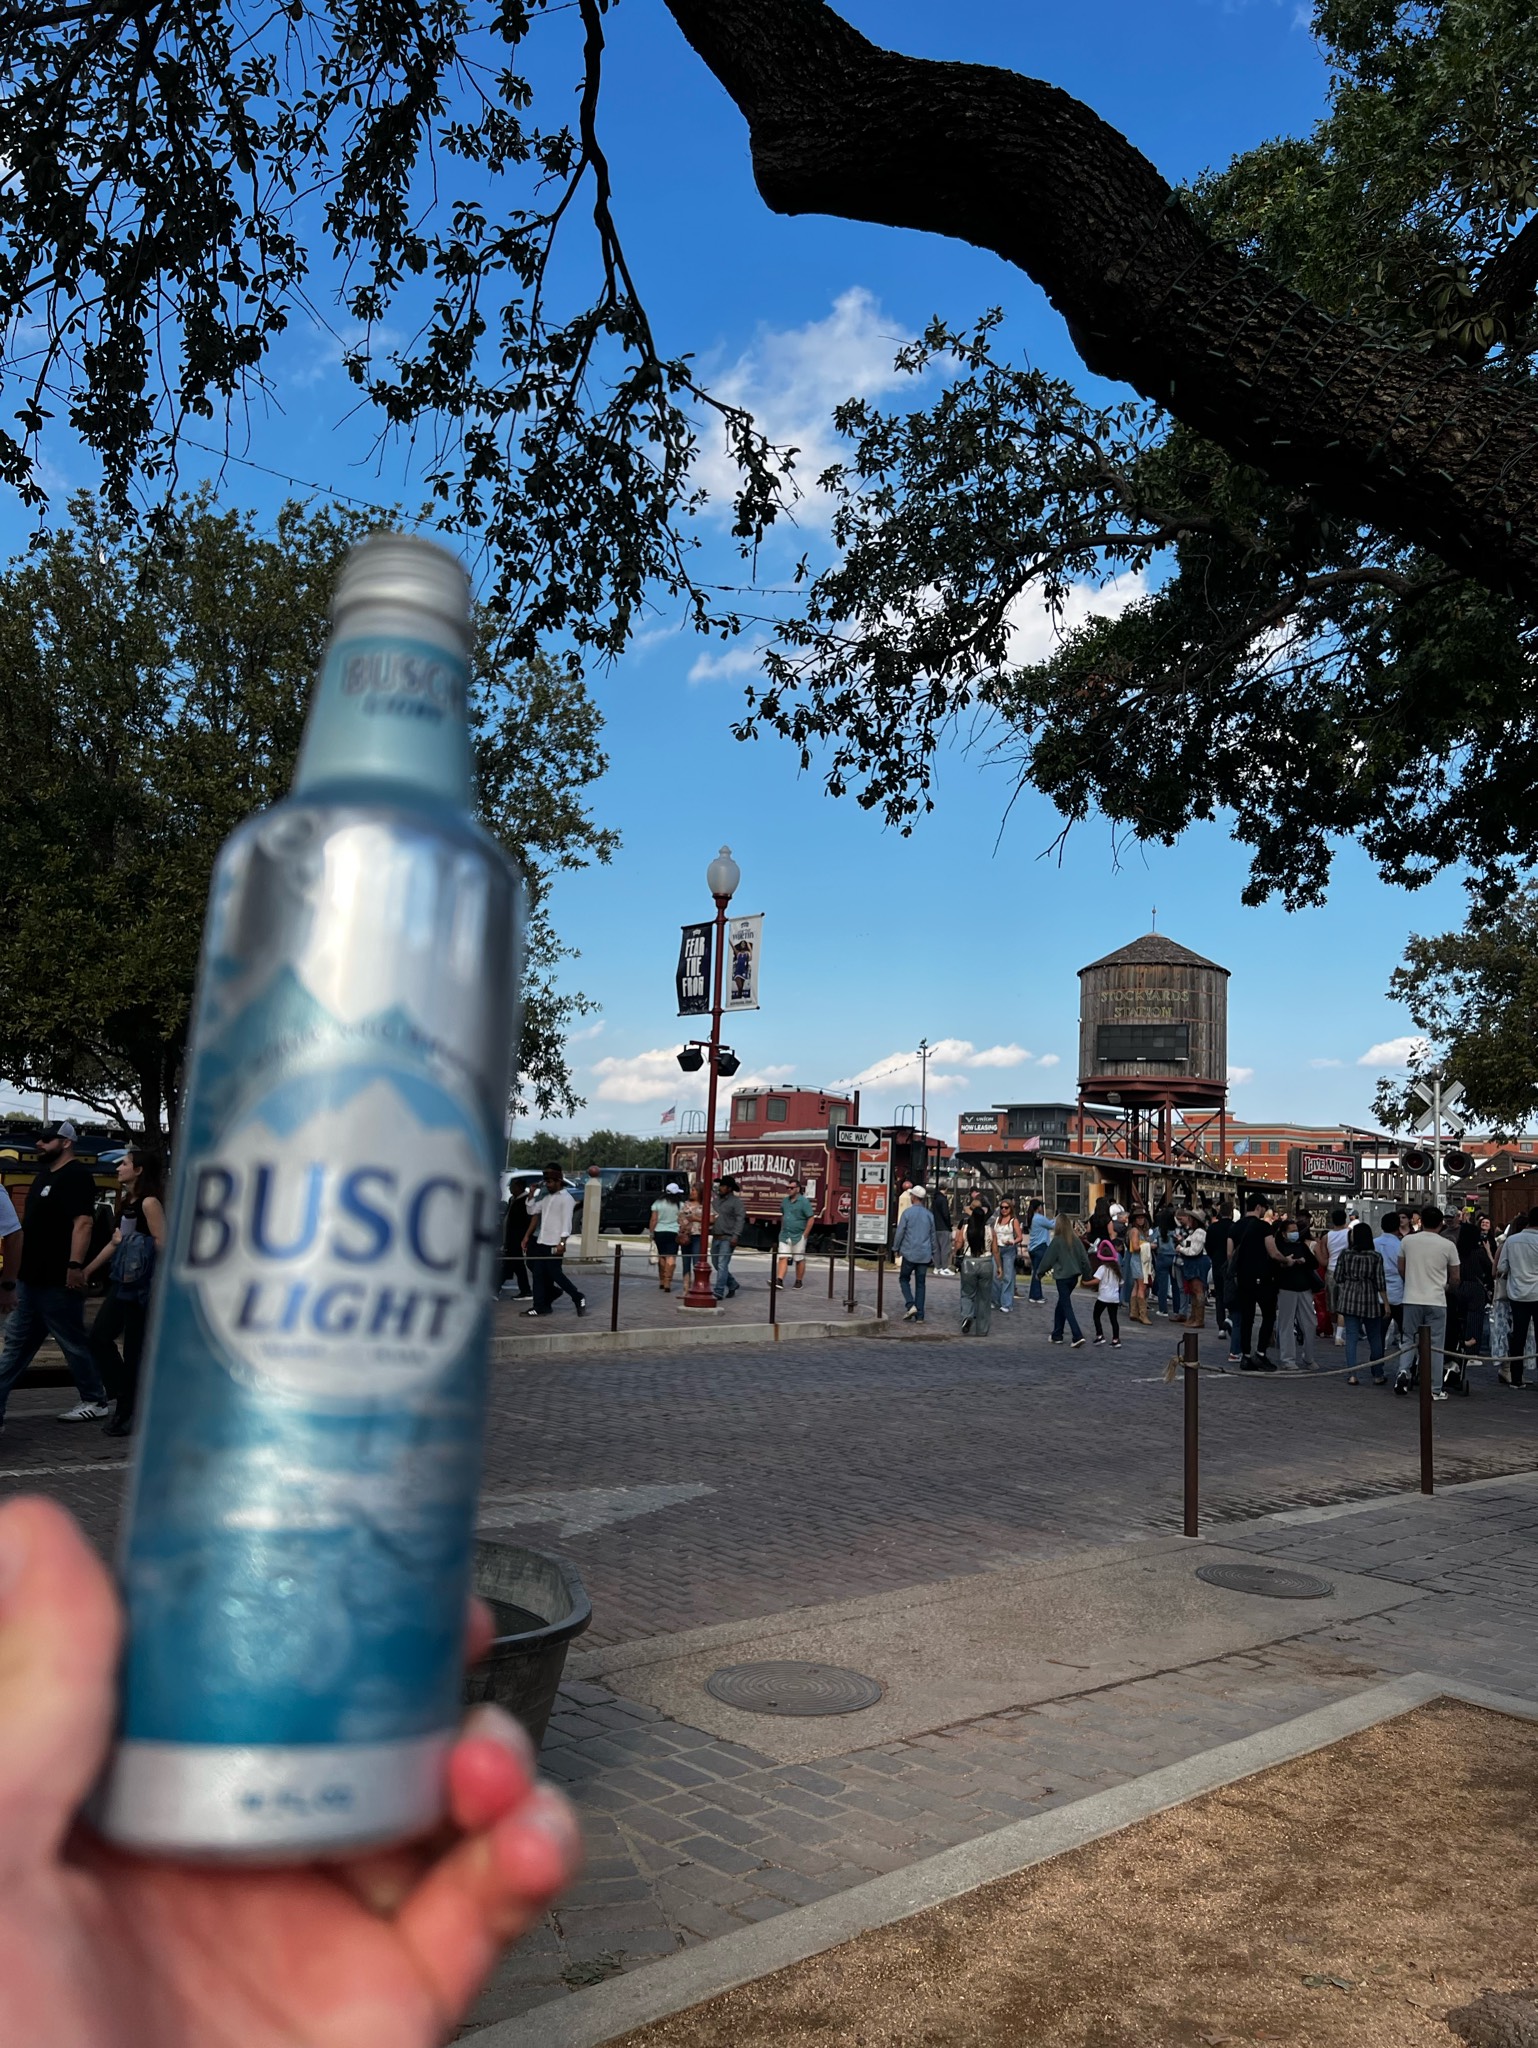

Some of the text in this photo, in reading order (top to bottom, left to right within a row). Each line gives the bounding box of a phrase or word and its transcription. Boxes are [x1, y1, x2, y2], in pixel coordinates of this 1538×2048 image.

[341, 654, 461, 706] BUSC
[685, 936, 706, 958] FEAR
[686, 957, 702, 976] THE
[682, 976, 704, 997] FROG
[1100, 989, 1190, 1003] STOCKYARDS
[1114, 1006, 1173, 1018] STATION
[840, 1132, 868, 1142] ONE WAY
[975, 1124, 998, 1132] LEASING
[723, 1156, 745, 1176] RIDE
[746, 1154, 765, 1172] THE
[766, 1155, 796, 1177] RAILS
[1304, 1156, 1353, 1179] LIVE MUSIC
[237, 1282, 456, 1343] LIGHT
